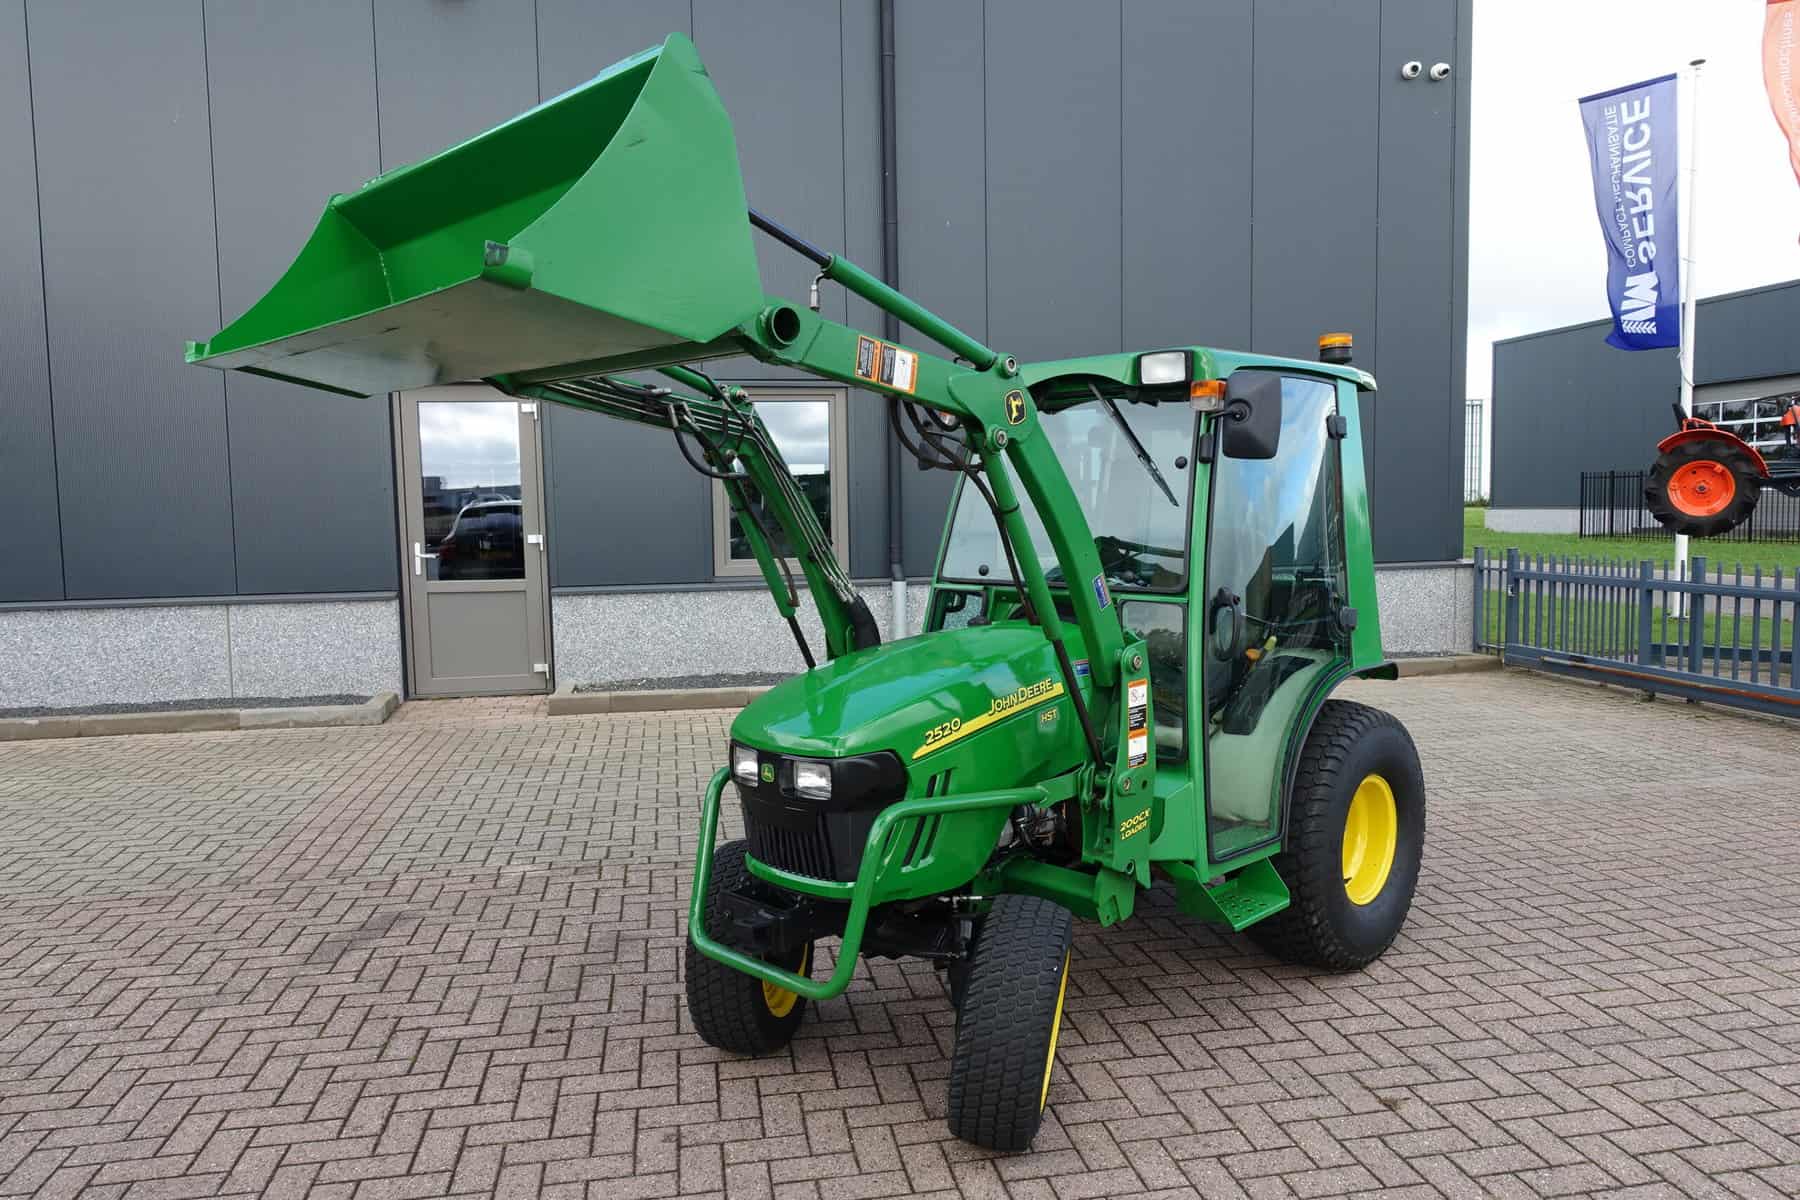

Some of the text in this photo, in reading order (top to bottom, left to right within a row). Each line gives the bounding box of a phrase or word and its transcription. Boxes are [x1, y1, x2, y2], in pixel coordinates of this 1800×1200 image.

[988, 678, 1053, 716] JOHN DEERE
[1041, 709, 1057, 723] HST
[925, 718, 961, 745] 2520
[1121, 820, 1148, 841] LOADER
